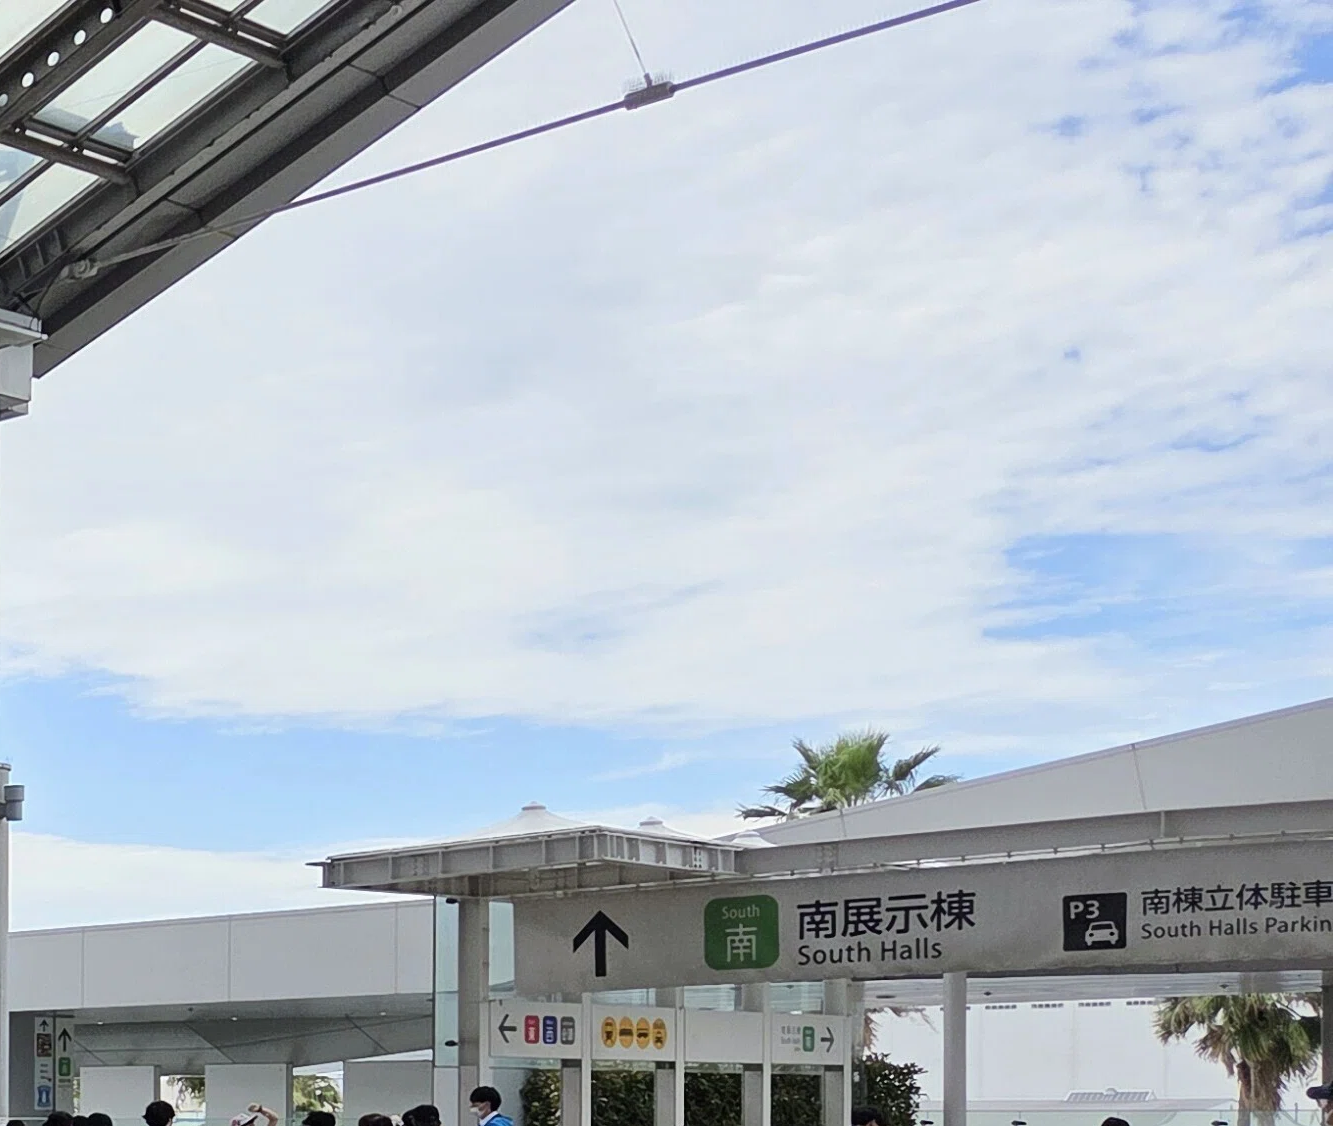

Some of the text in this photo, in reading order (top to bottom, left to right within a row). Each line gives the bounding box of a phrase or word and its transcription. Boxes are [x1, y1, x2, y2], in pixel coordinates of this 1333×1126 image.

[721, 903, 761, 920] South
[796, 889, 977, 940] 南展示棟
[1069, 900, 1100, 919] P3
[1141, 915, 1332, 940] South Halls Parkin
[724, 923, 758, 963] 南
[797, 936, 943, 966] South Halls
